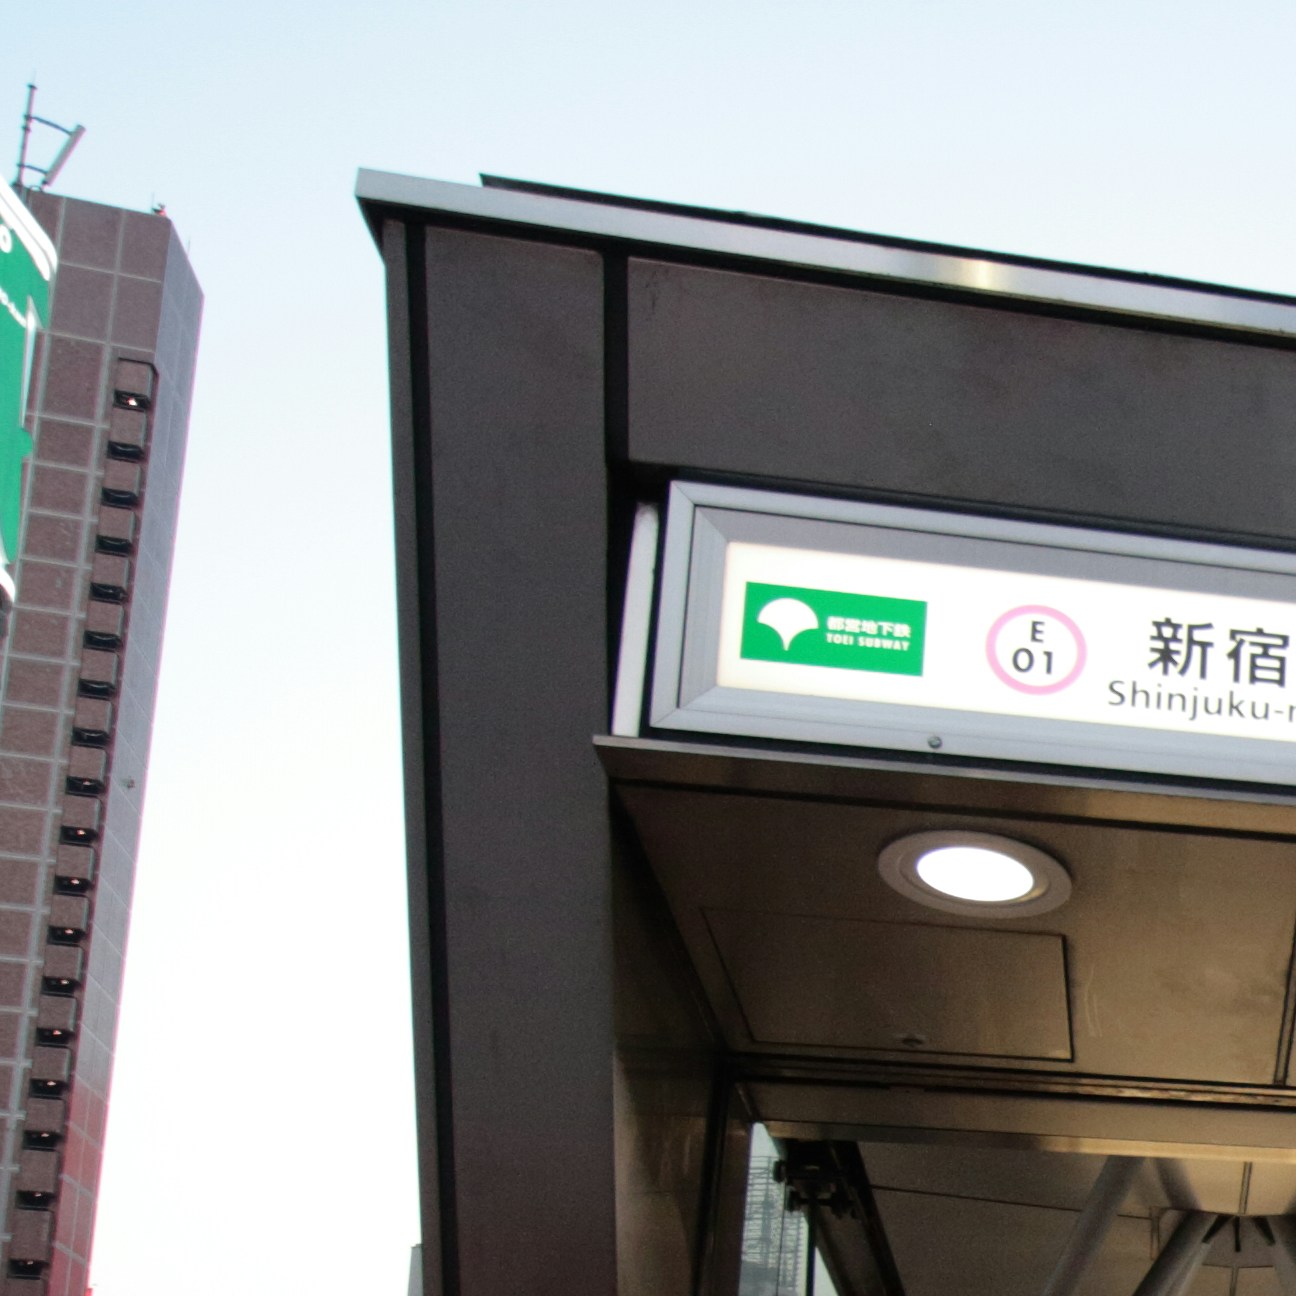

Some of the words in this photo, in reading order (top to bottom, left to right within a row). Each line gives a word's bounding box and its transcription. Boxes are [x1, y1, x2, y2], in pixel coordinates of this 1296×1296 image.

[826, 615, 912, 638] 都営地下鉄
[1030, 620, 1044, 644] E
[826, 632, 855, 647] TOEI
[857, 636, 910, 652] SUBWAY
[1011, 648, 1055, 676] 01
